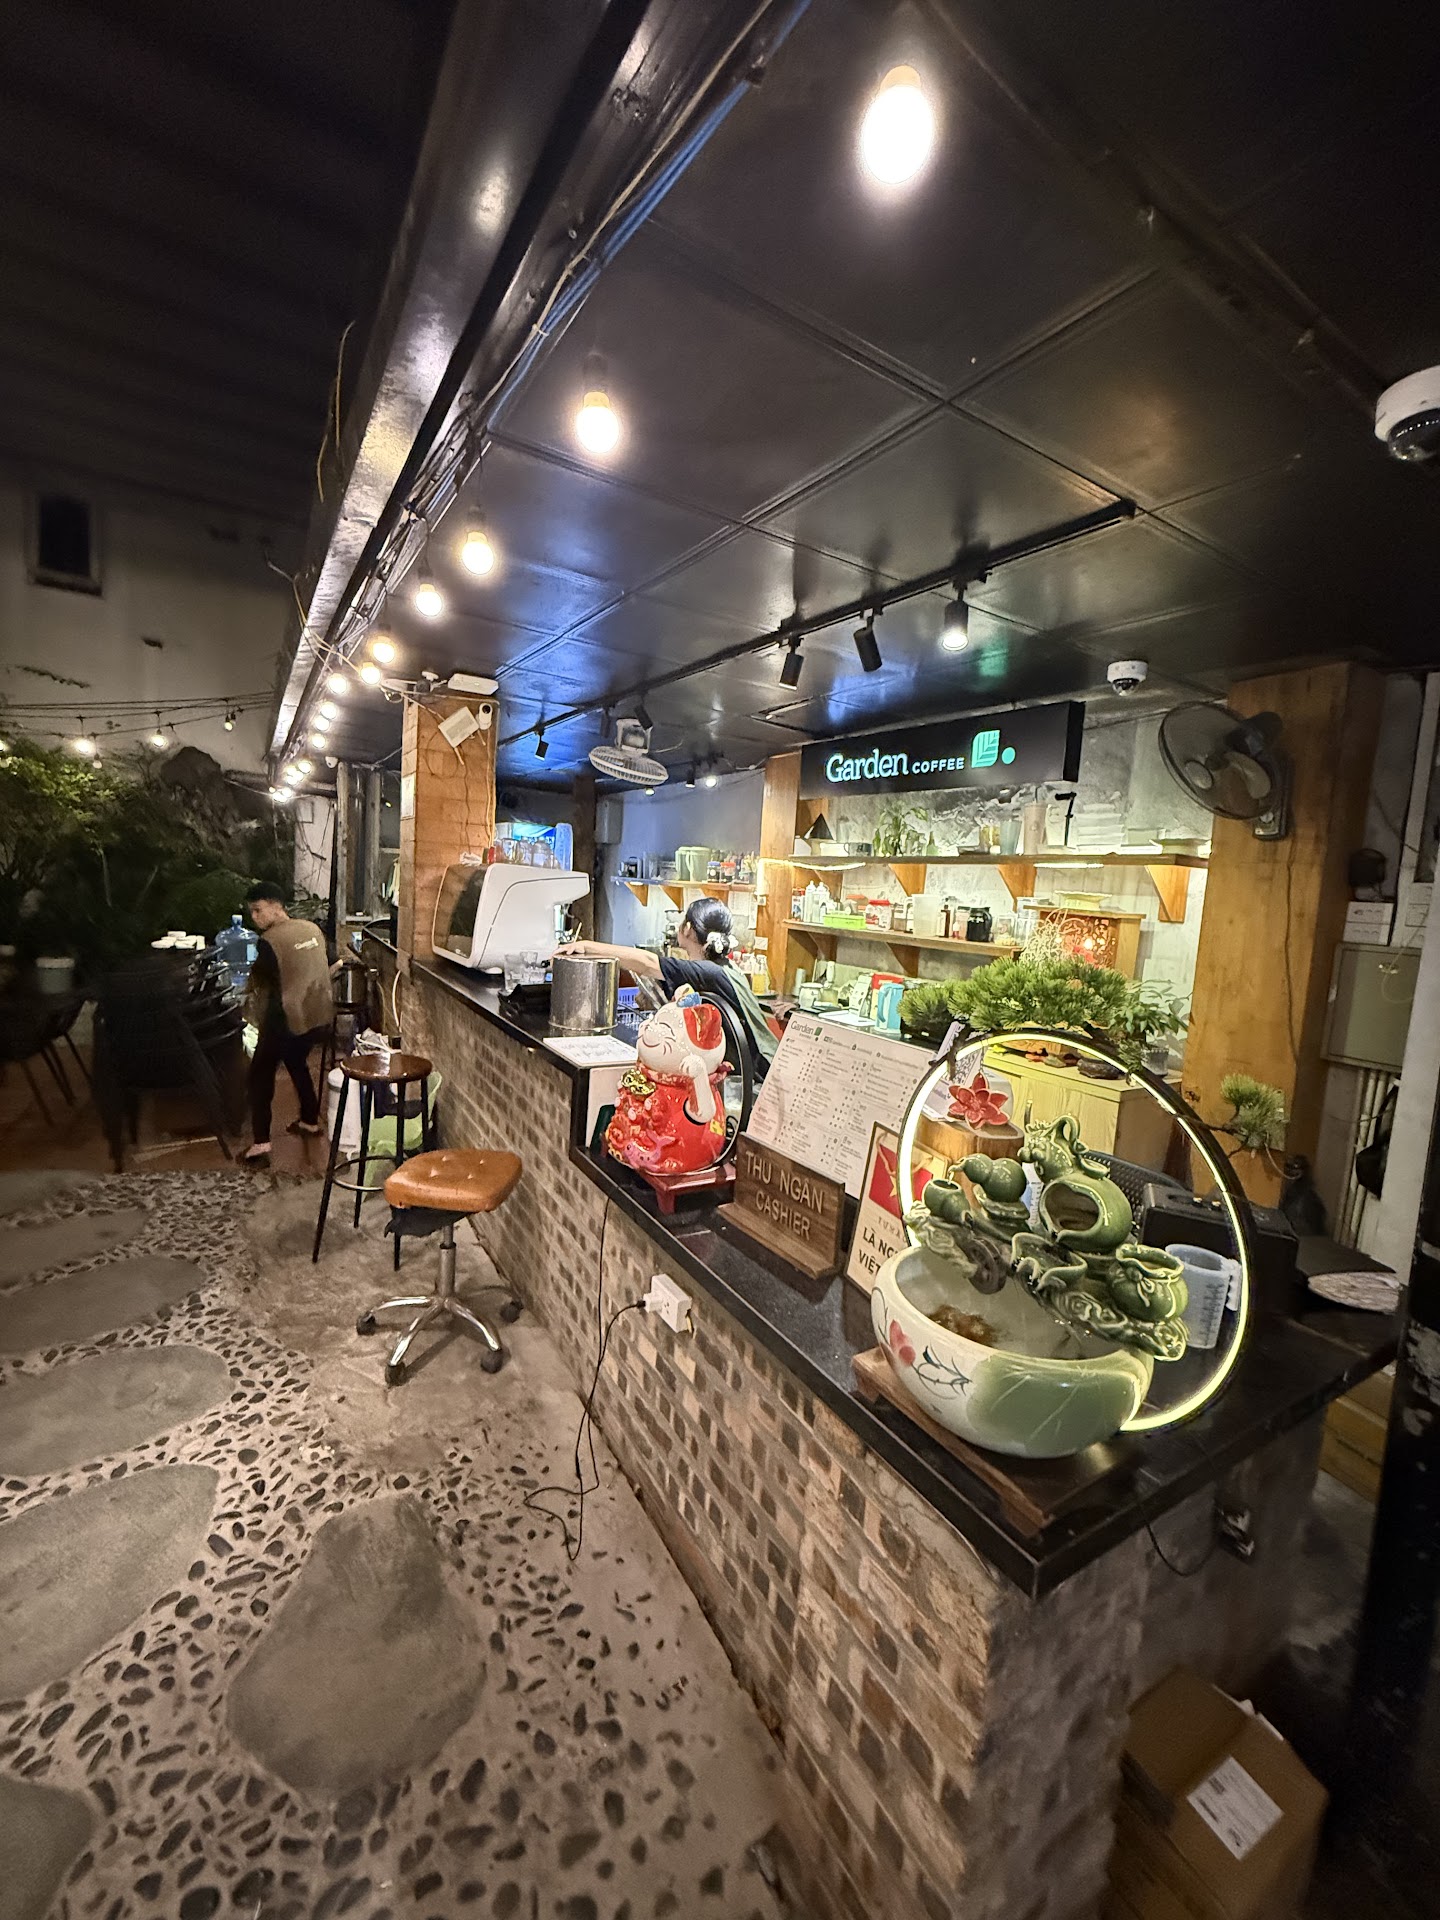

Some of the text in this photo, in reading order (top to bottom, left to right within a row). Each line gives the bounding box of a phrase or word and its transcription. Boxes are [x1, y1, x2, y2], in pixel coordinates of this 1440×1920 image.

[826, 748, 964, 783] Garden COFFEE
[790, 1020, 814, 1035] Garden
[746, 1150, 824, 1215] THU NGÂN
[756, 1190, 810, 1241] CASHIER
[863, 1226, 876, 1248] LÀ
